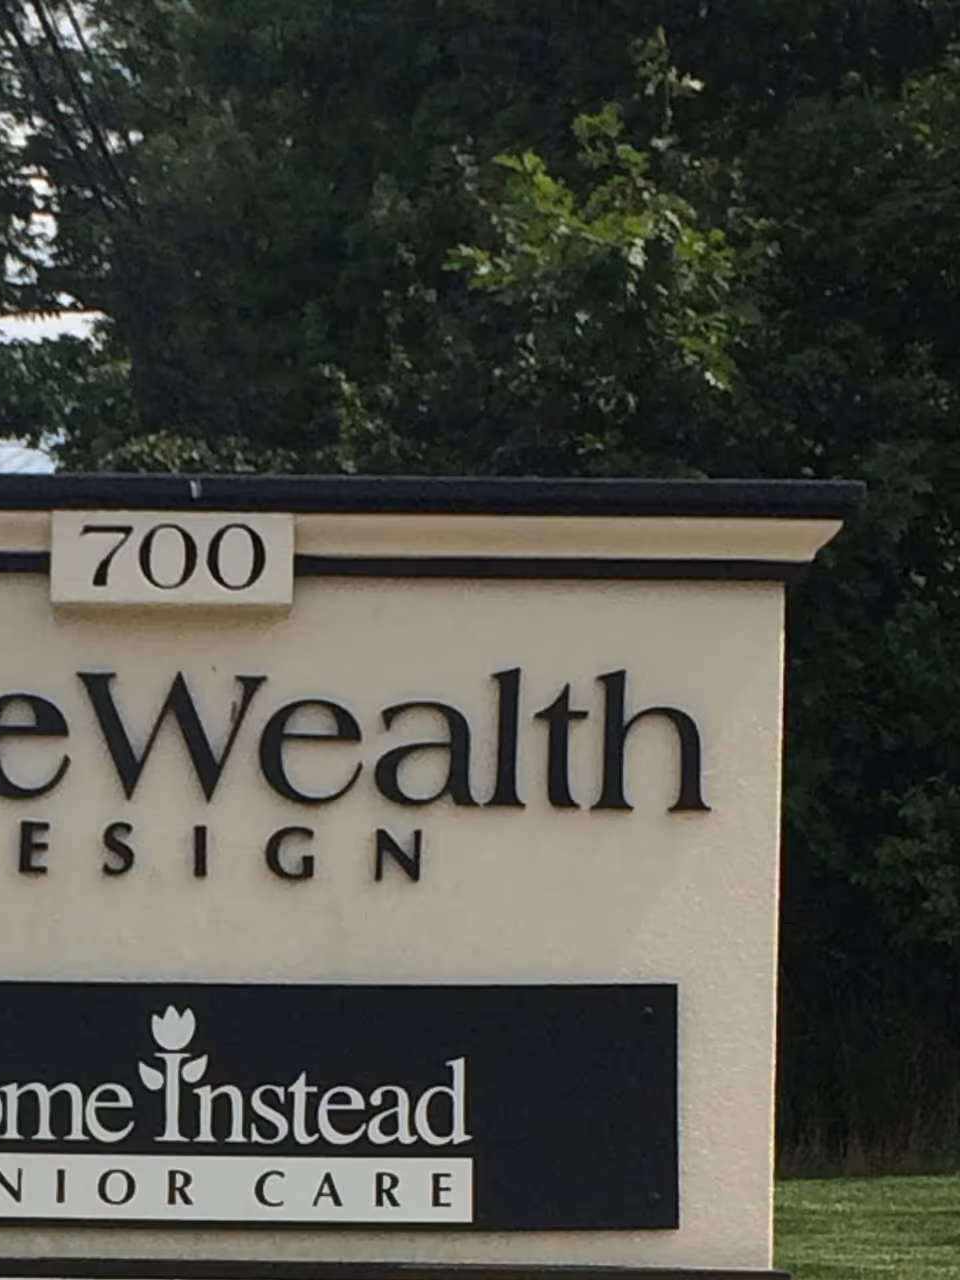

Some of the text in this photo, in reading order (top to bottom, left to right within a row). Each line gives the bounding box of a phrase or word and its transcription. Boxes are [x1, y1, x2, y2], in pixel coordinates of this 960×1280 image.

[79, 523, 267, 591] 700
[153, 1052, 473, 1146] Instead
[254, 1169, 452, 1208] CARE
